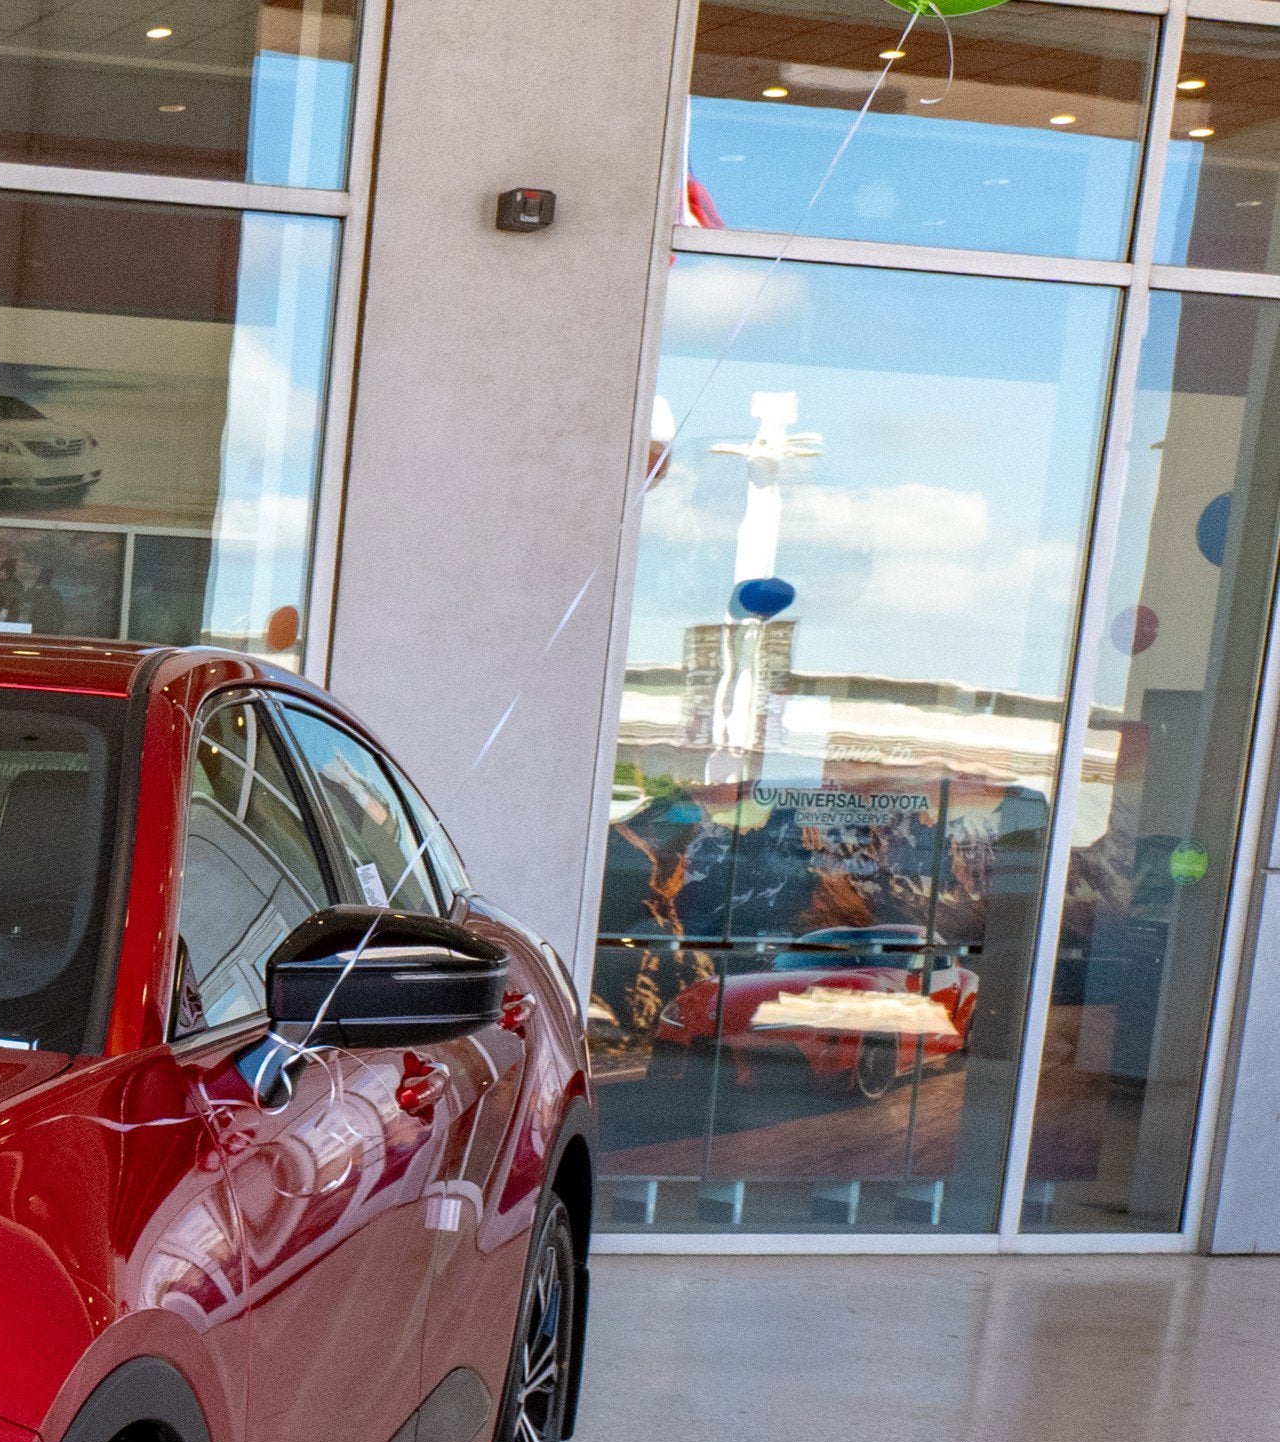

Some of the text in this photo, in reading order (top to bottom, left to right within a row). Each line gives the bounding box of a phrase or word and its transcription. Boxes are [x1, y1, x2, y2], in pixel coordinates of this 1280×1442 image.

[778, 791, 930, 811] UNIVERSAL TOYOTA
[796, 811, 836, 823] DRIVEN
